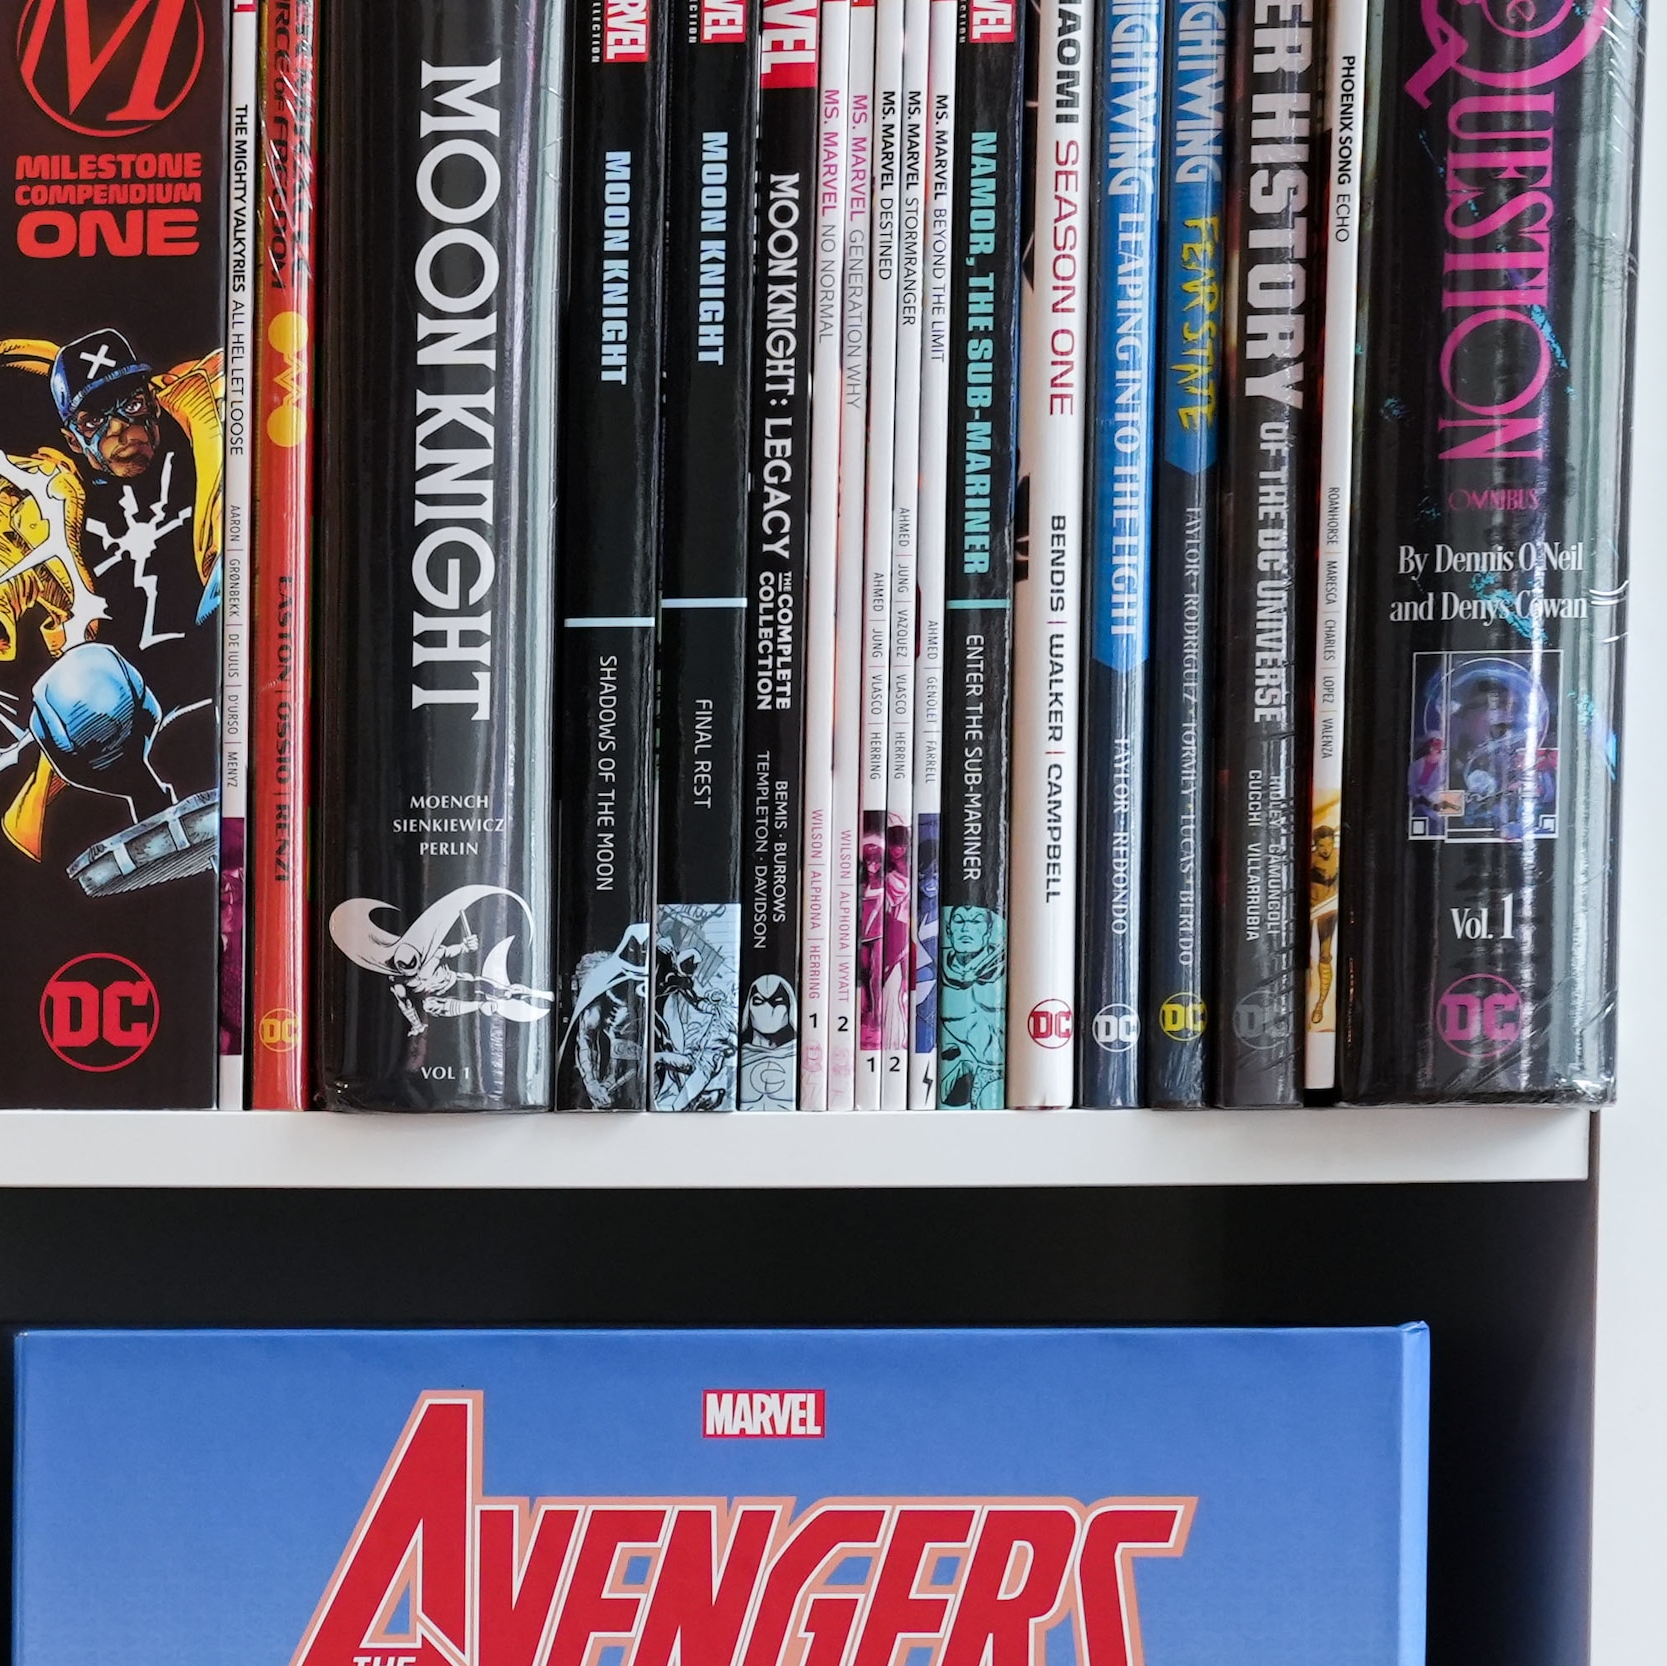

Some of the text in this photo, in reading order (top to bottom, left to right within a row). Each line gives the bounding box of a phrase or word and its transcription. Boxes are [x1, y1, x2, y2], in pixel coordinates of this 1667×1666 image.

[16, 153, 202, 180] MILESTONE
[1335, 56, 1355, 242] PHOENIX SONG ECHO
[15, 182, 201, 205] COMPENDIUM
[17, 209, 199, 258] ONE
[1050, 141, 1077, 415] SEASON ONE
[964, 132, 997, 573] NAMOR, THE SUB-MARINER
[412, 56, 501, 720] MOON KNIGHT
[596, 656, 617, 890] SHADOWS OF THE MOON
[393, 818, 505, 832] SIENKIEWICZ
[410, 795, 489, 808] MOENCH
[420, 842, 478, 855] PERLIN
[1450, 894, 1514, 940] Vol. 1
[51, 980, 152, 1048] DC
[704, 1392, 822, 1436] MARVEL
